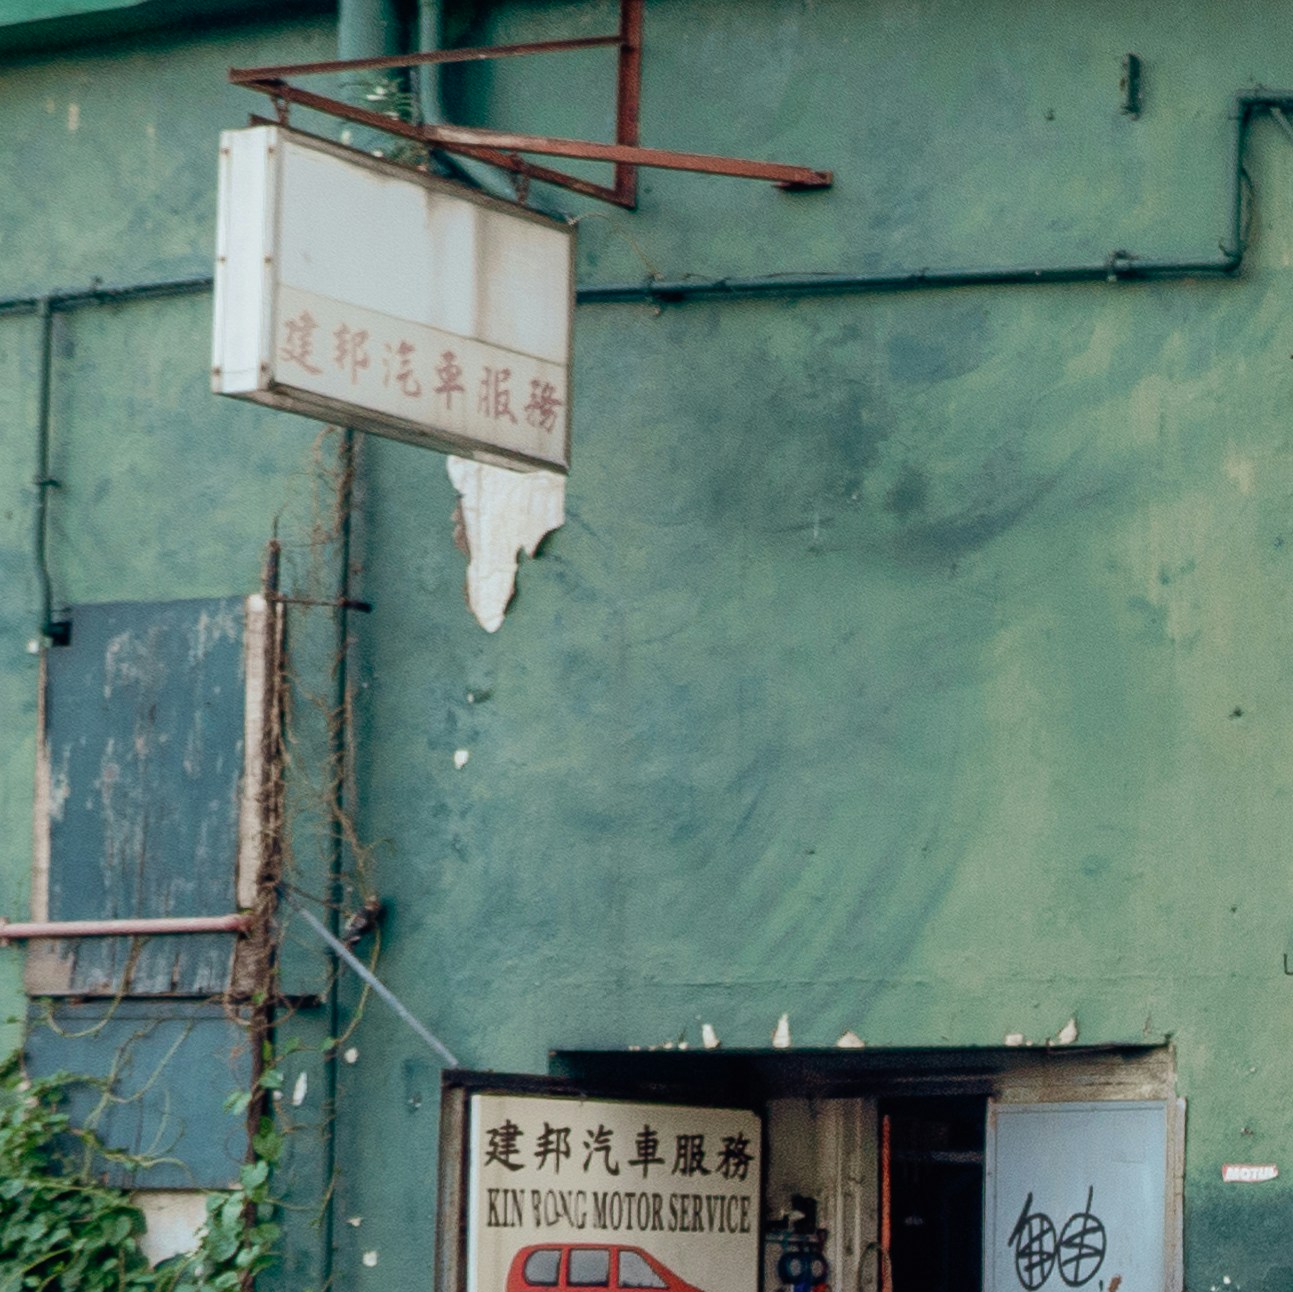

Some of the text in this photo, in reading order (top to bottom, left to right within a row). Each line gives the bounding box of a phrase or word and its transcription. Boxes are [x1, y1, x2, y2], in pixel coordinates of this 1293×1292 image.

[280, 310, 563, 434] 建邦汽車服務
[484, 1118, 754, 1182] 建邦汽車服務
[486, 1187, 525, 1228] KIN
[592, 1191, 664, 1231] MOTOR
[668, 1192, 751, 1233] SERVICE
